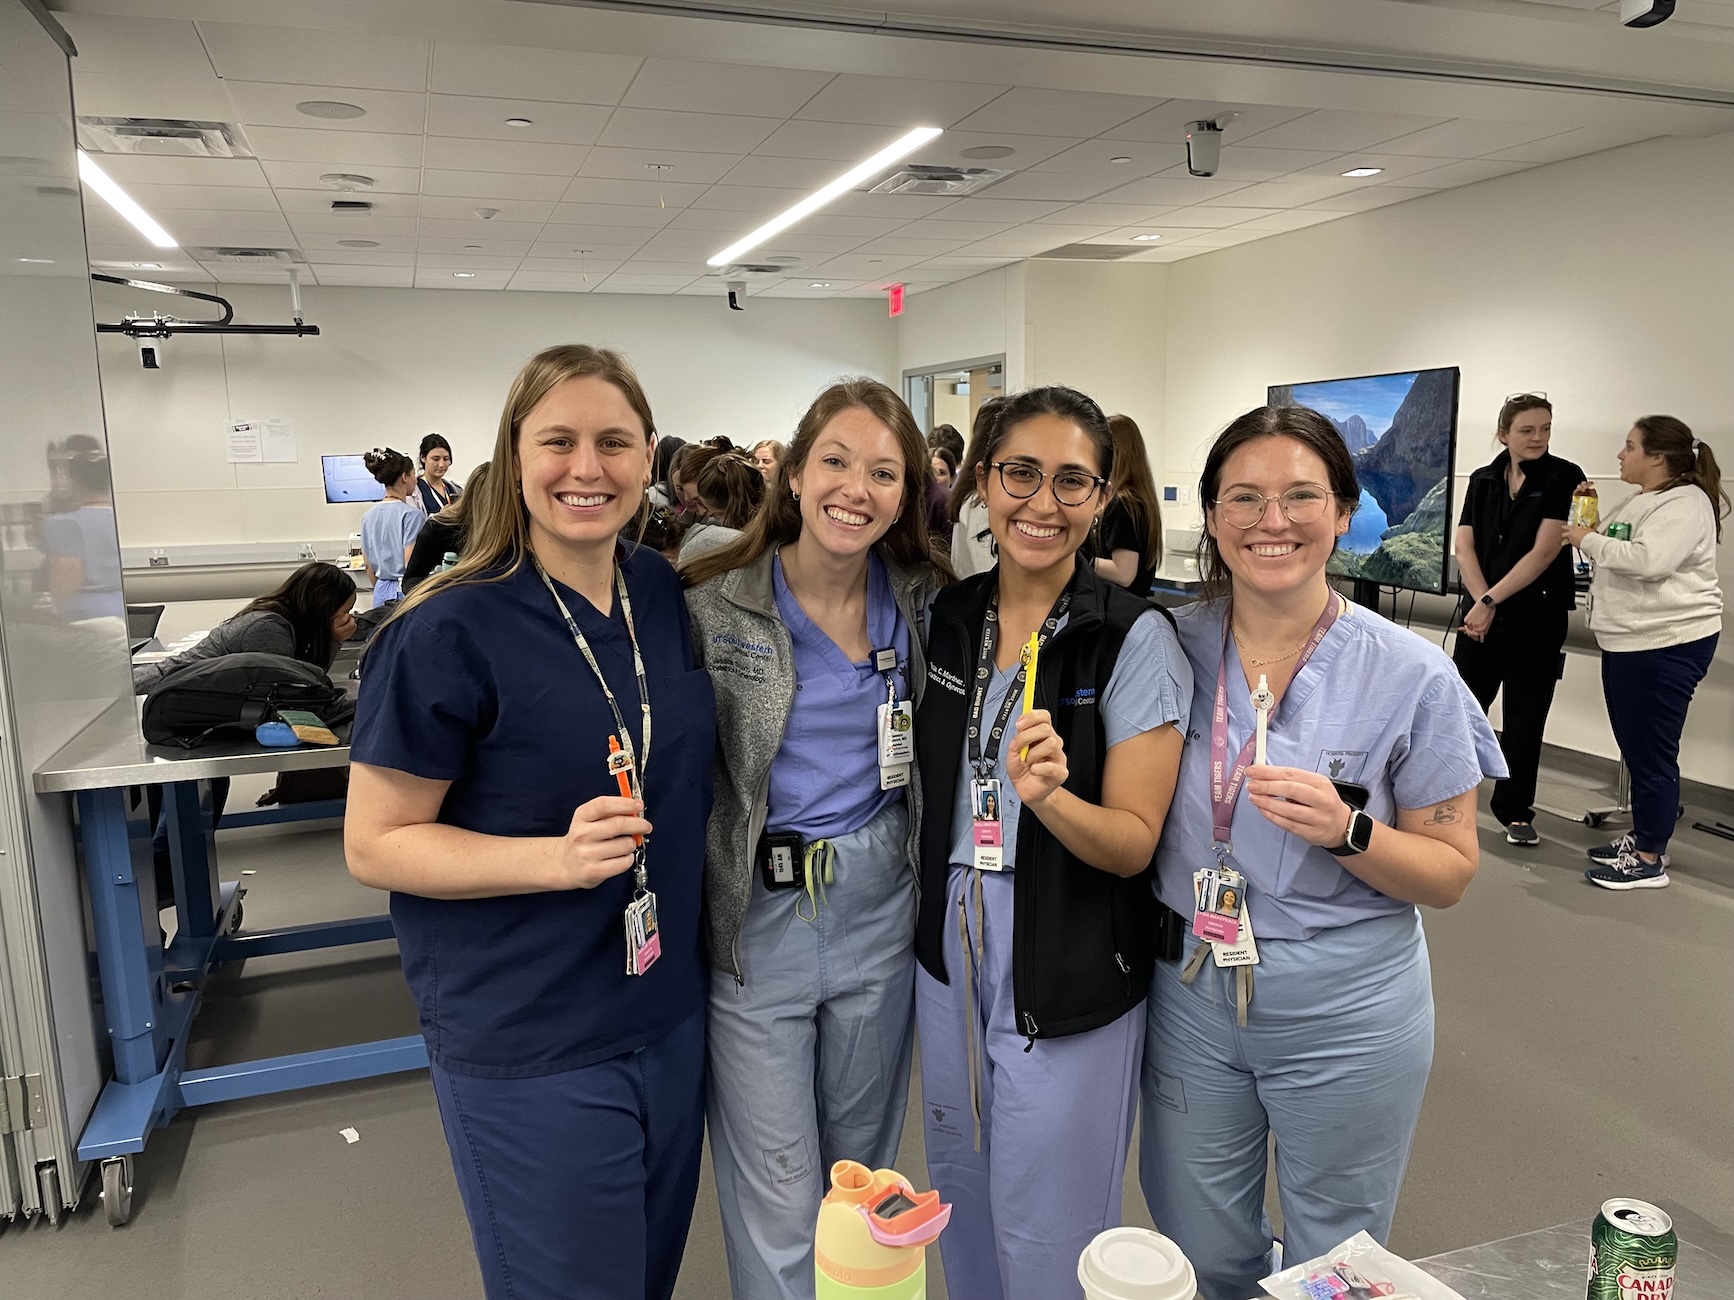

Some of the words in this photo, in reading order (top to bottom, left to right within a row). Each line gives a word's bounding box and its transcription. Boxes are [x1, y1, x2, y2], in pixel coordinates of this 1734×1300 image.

[1314, 626, 1327, 643] TEAM
[1302, 641, 1317, 663] TIGERS
[974, 686, 984, 707] BUNNY
[1217, 684, 1225, 706] TIGERS
[972, 706, 980, 719] BAD
[1215, 706, 1224, 723] TEAM
[886, 772, 905, 780] RESIDENT
[1213, 760, 1223, 783] TIGERS
[1232, 764, 1246, 782] TEAM
[886, 777, 905, 786] PHYSICIAN
[1214, 784, 1223, 803] TEAM
[1224, 782, 1238, 805] TIGERS
[1222, 949, 1248, 957] RESIDENT
[1222, 955, 1251, 963] PHYSICIAN
